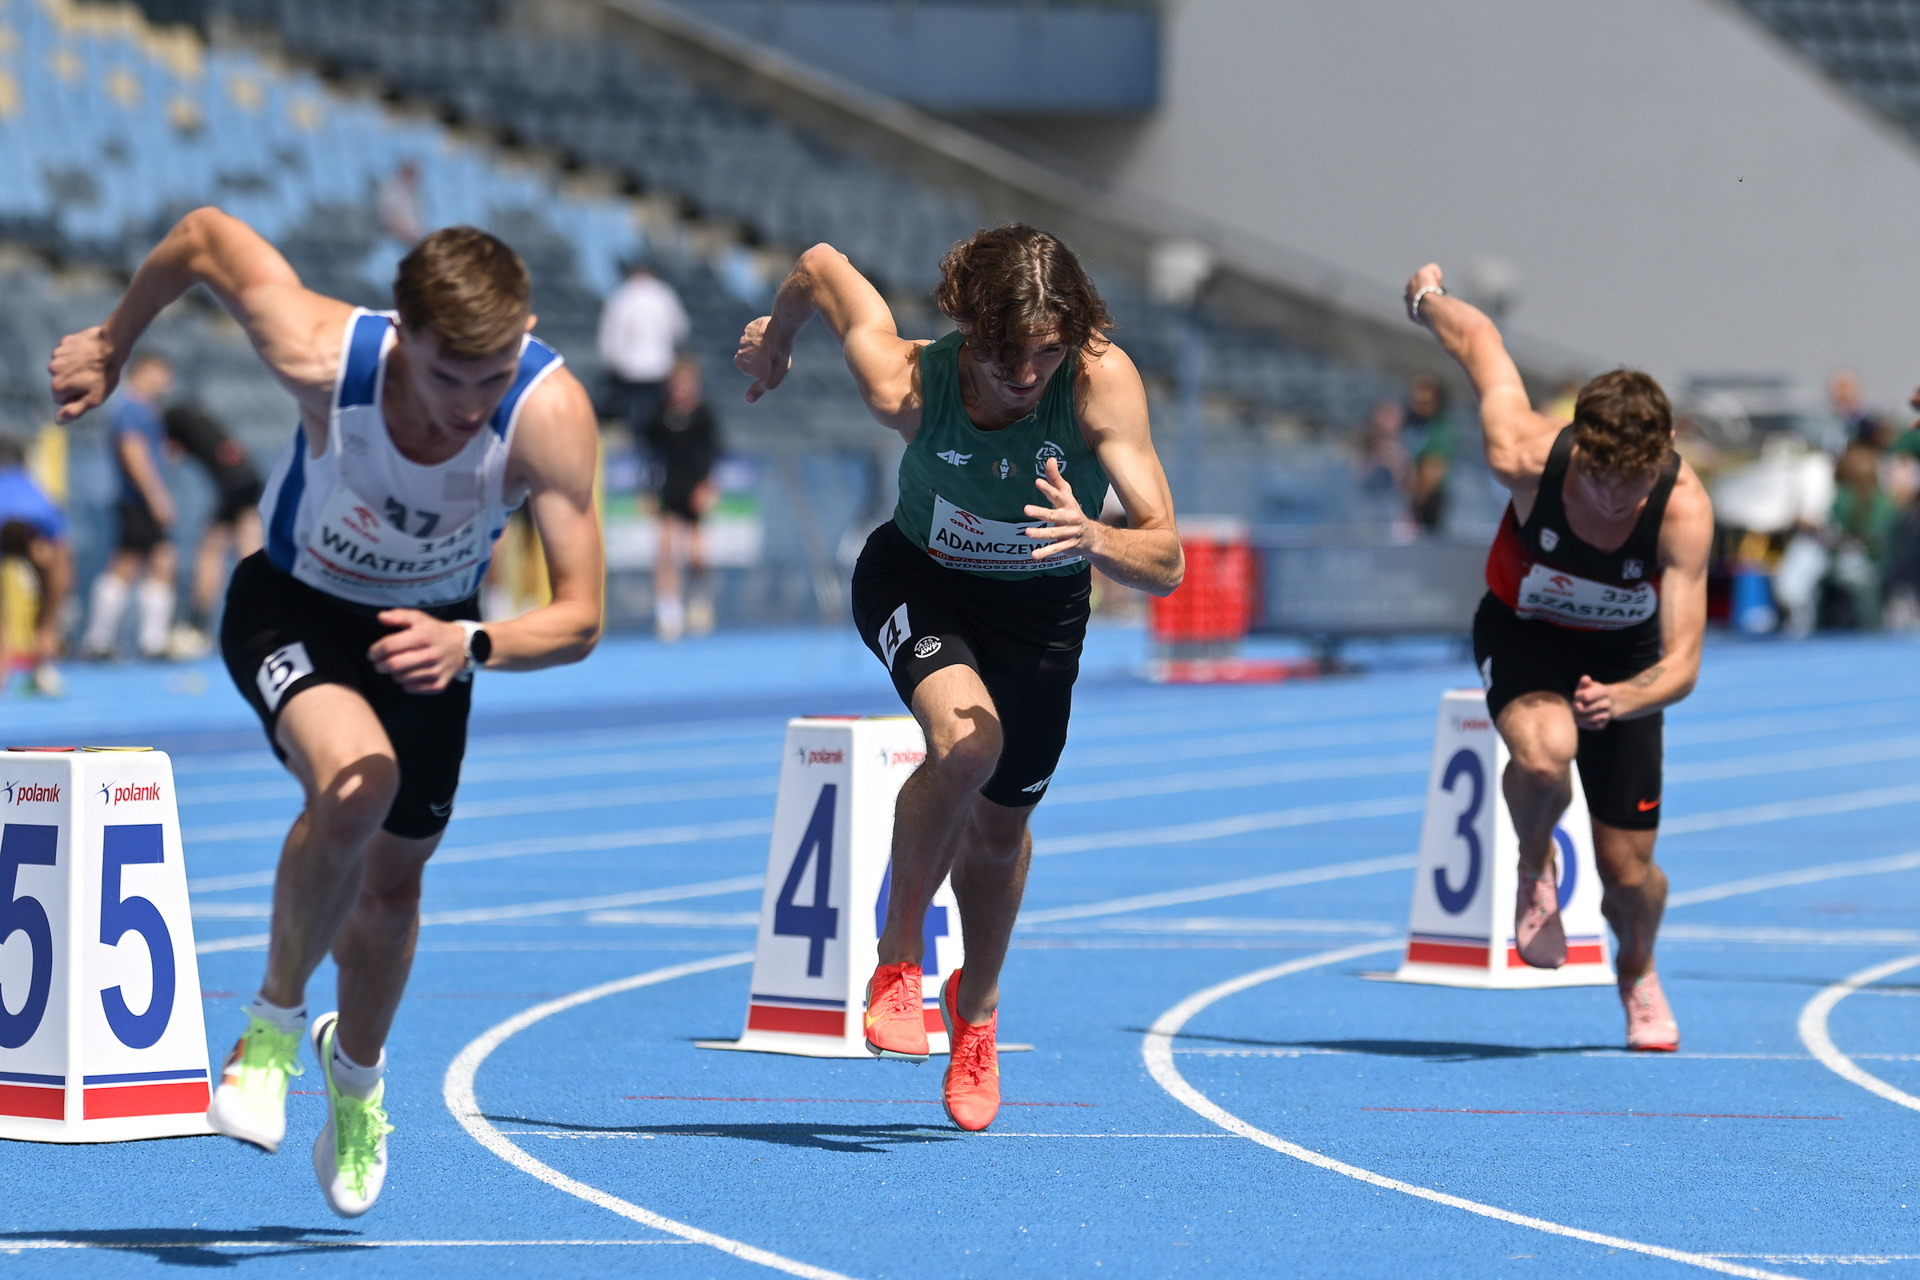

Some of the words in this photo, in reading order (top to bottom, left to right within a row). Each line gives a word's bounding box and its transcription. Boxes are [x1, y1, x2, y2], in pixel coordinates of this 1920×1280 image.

[999, 458, 1010, 480] AWF
[950, 518, 985, 536] ORLEN
[322, 525, 476, 574] WIATRZYK
[945, 562, 1026, 570] BYDGOSZCZ
[1526, 593, 1648, 618] SZASTAK
[886, 614, 901, 648] 4
[267, 650, 294, 693] 5
[808, 747, 845, 768] polanik
[892, 747, 927, 768] polan
[17, 783, 61, 807] polanik
[114, 782, 161, 807] polanik
[1433, 749, 1486, 916] 3
[773, 783, 839, 978] 4
[0, 823, 59, 1050] 5
[99, 823, 176, 1050] 5
